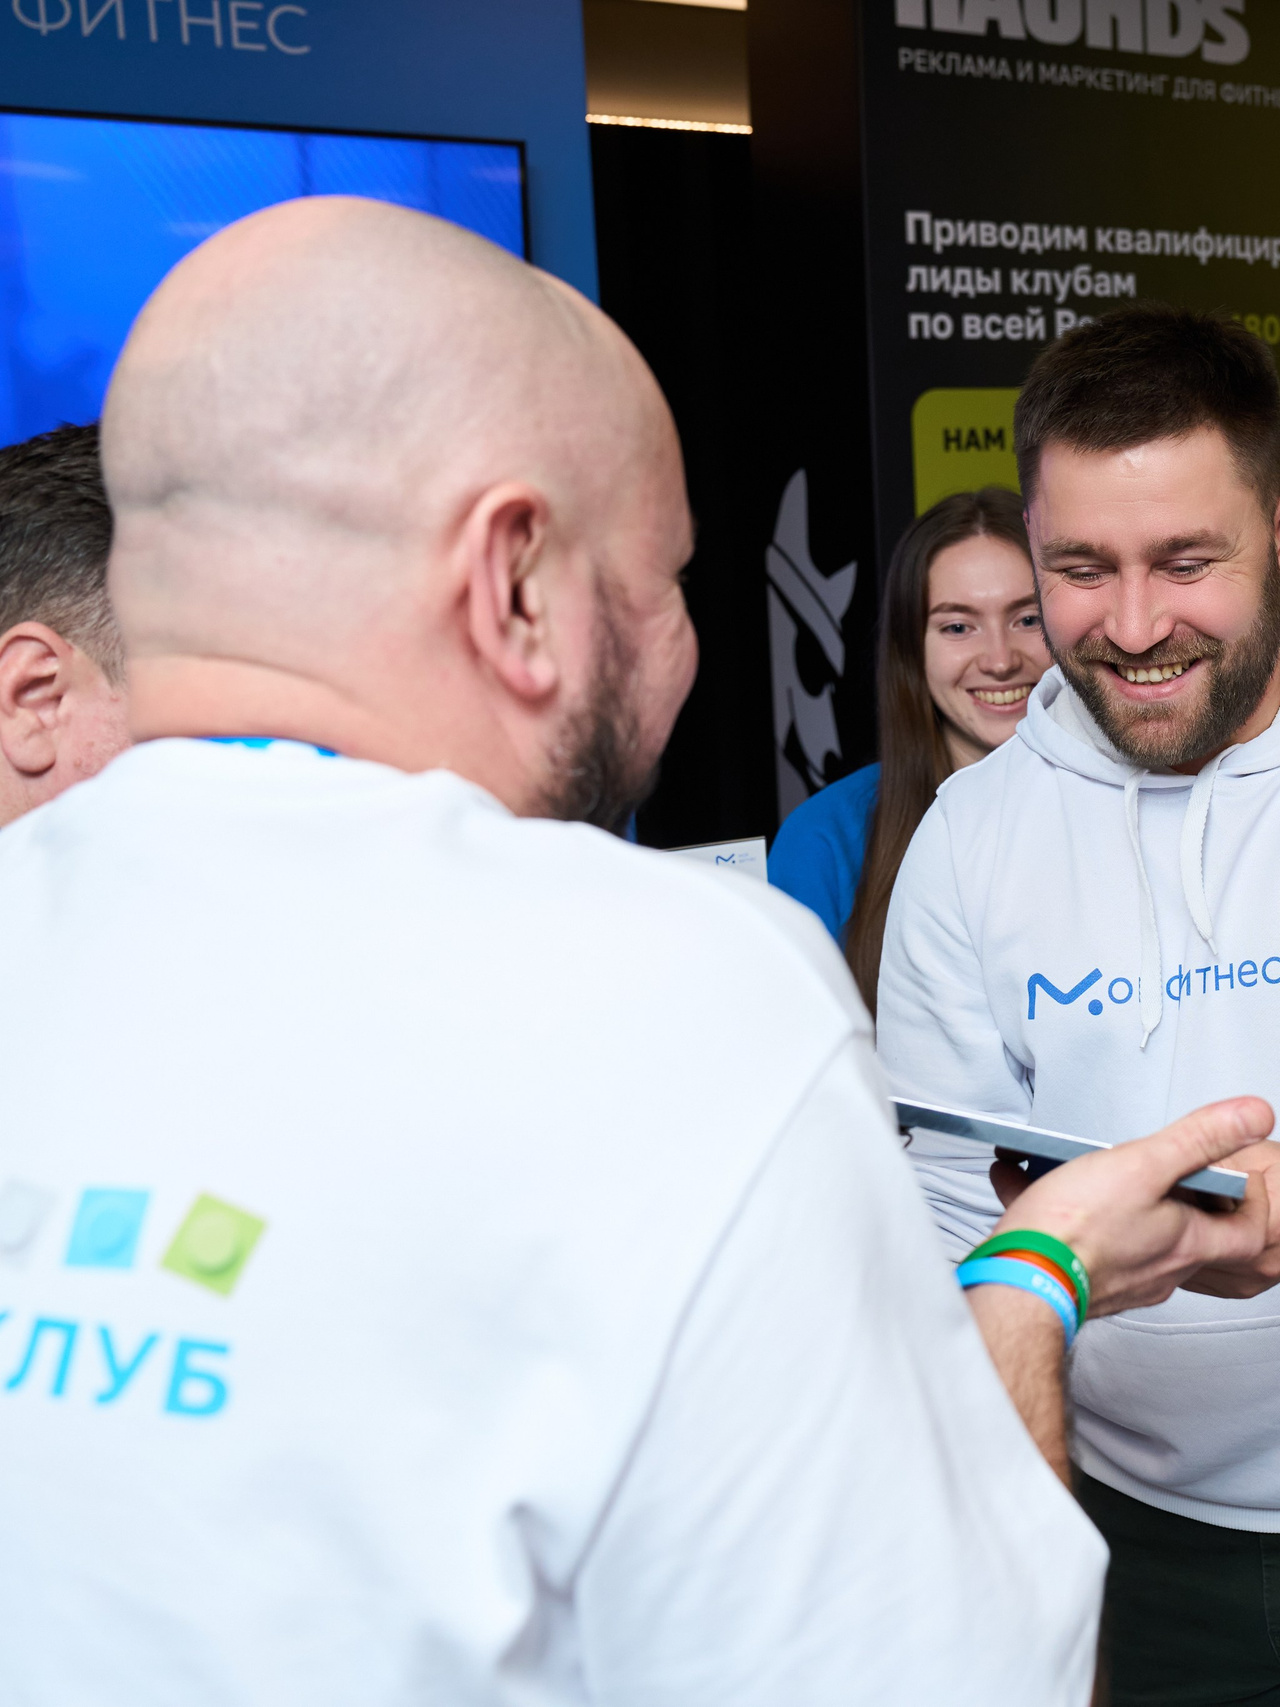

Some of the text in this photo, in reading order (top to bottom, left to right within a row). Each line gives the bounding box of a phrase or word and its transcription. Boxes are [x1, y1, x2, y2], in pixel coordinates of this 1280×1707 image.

[899, 46, 1013, 81] РЕКЛАМА
[1016, 59, 1034, 84] И
[1038, 61, 1169, 96] МАРКЕТИНГ
[1172, 76, 1217, 102] ДЛЯ
[905, 210, 1087, 254] Приводим
[906, 264, 1136, 303] лиды клубам
[909, 311, 953, 340] по
[962, 308, 1046, 341] всей
[944, 427, 1005, 453] НАМ
[0, 1309, 230, 1417] ЛУБ
